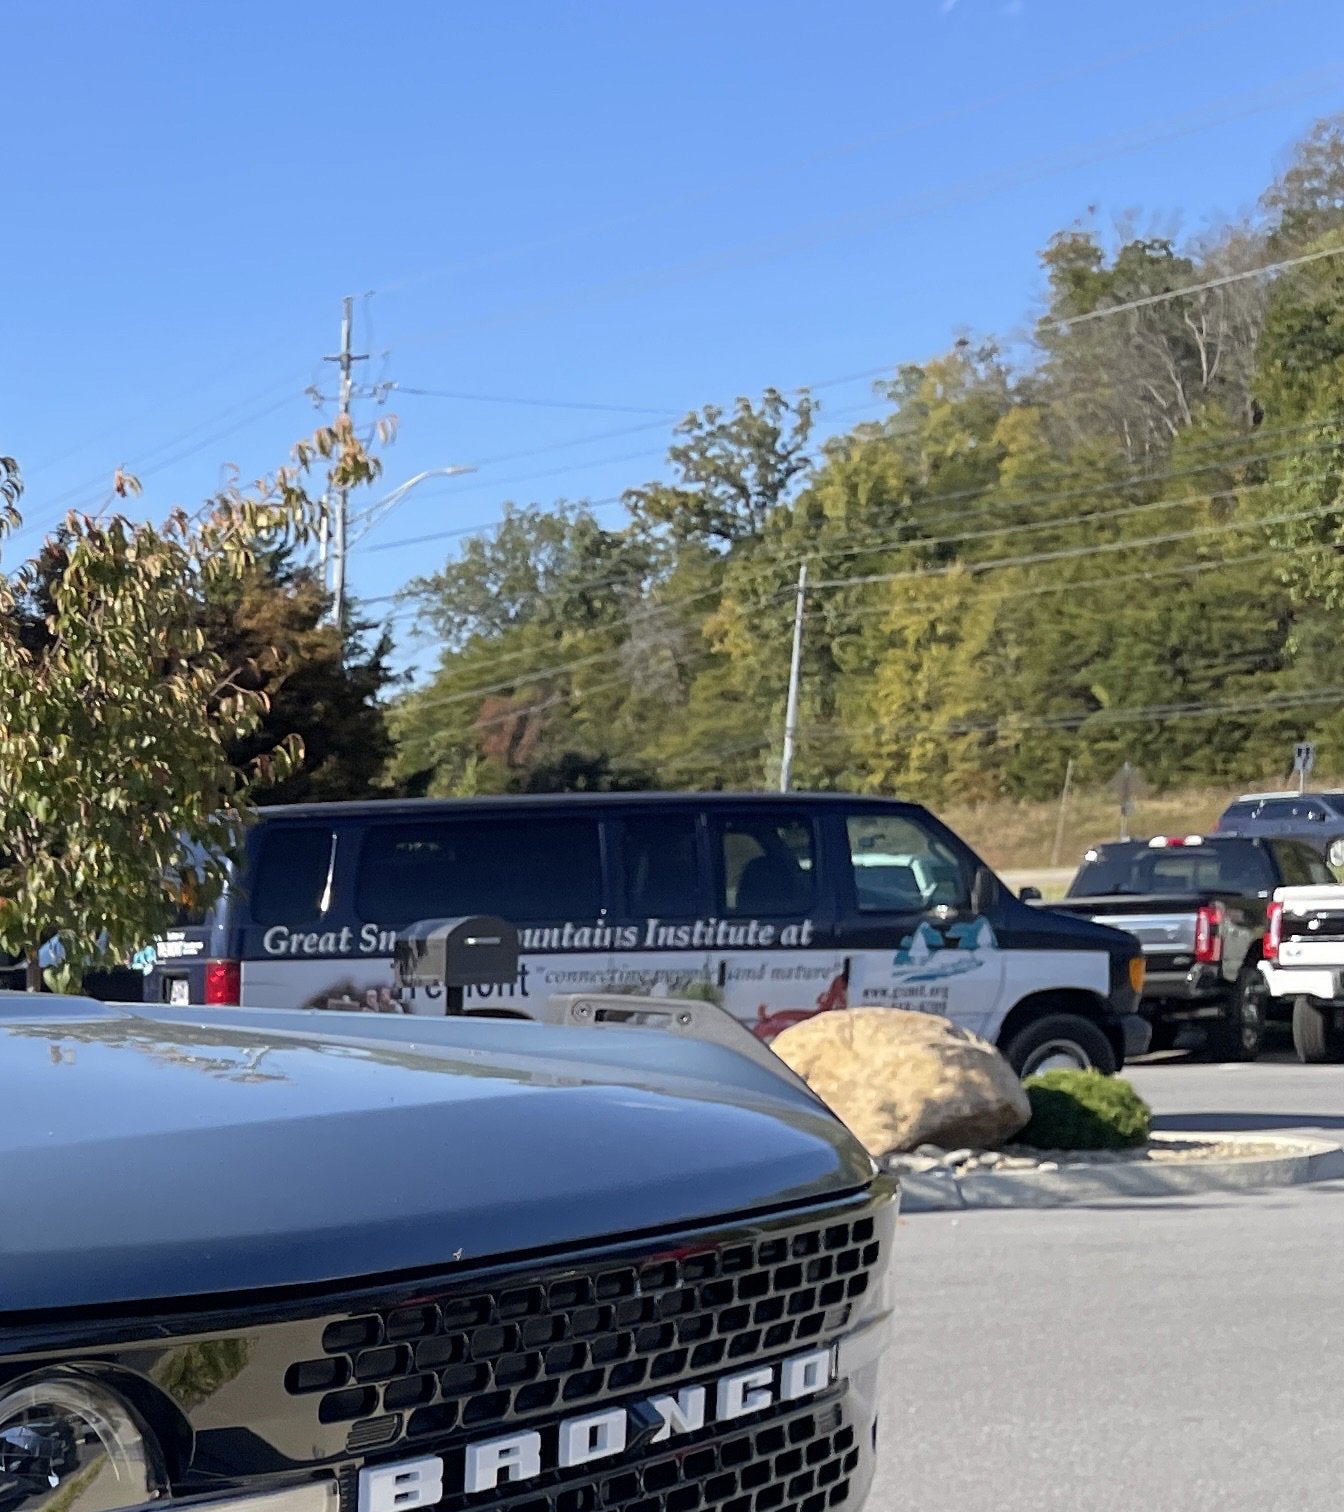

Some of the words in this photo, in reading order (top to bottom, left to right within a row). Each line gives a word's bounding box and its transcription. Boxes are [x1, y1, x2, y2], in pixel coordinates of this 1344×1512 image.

[263, 924, 353, 955] Great
[517, 919, 638, 948] untains
[645, 917, 775, 947] Institute
[780, 919, 813, 946] at
